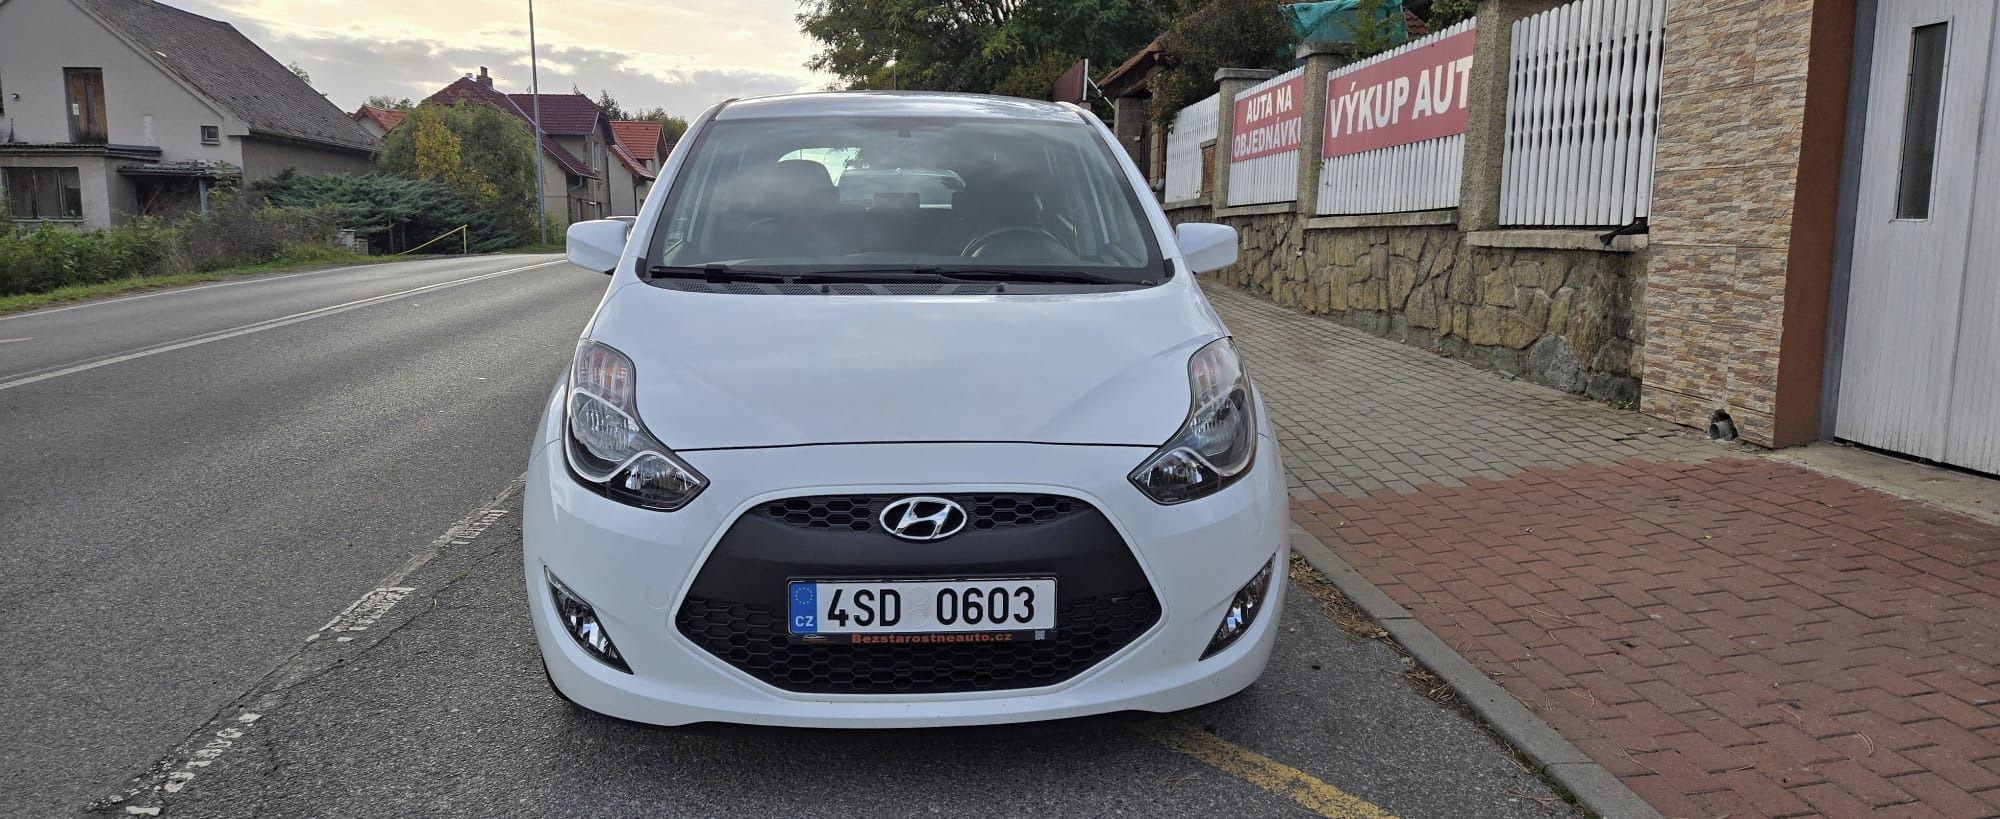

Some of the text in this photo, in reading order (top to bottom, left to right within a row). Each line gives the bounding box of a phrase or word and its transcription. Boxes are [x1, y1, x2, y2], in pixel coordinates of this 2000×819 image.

[1246, 85, 1292, 125] AUTA NA
[1330, 55, 1474, 138] VÝKUP AUT
[795, 616, 814, 627] CZ
[827, 586, 1035, 627] 4SD 0603
[851, 632, 1013, 644] Bezstarostneauto.cz
